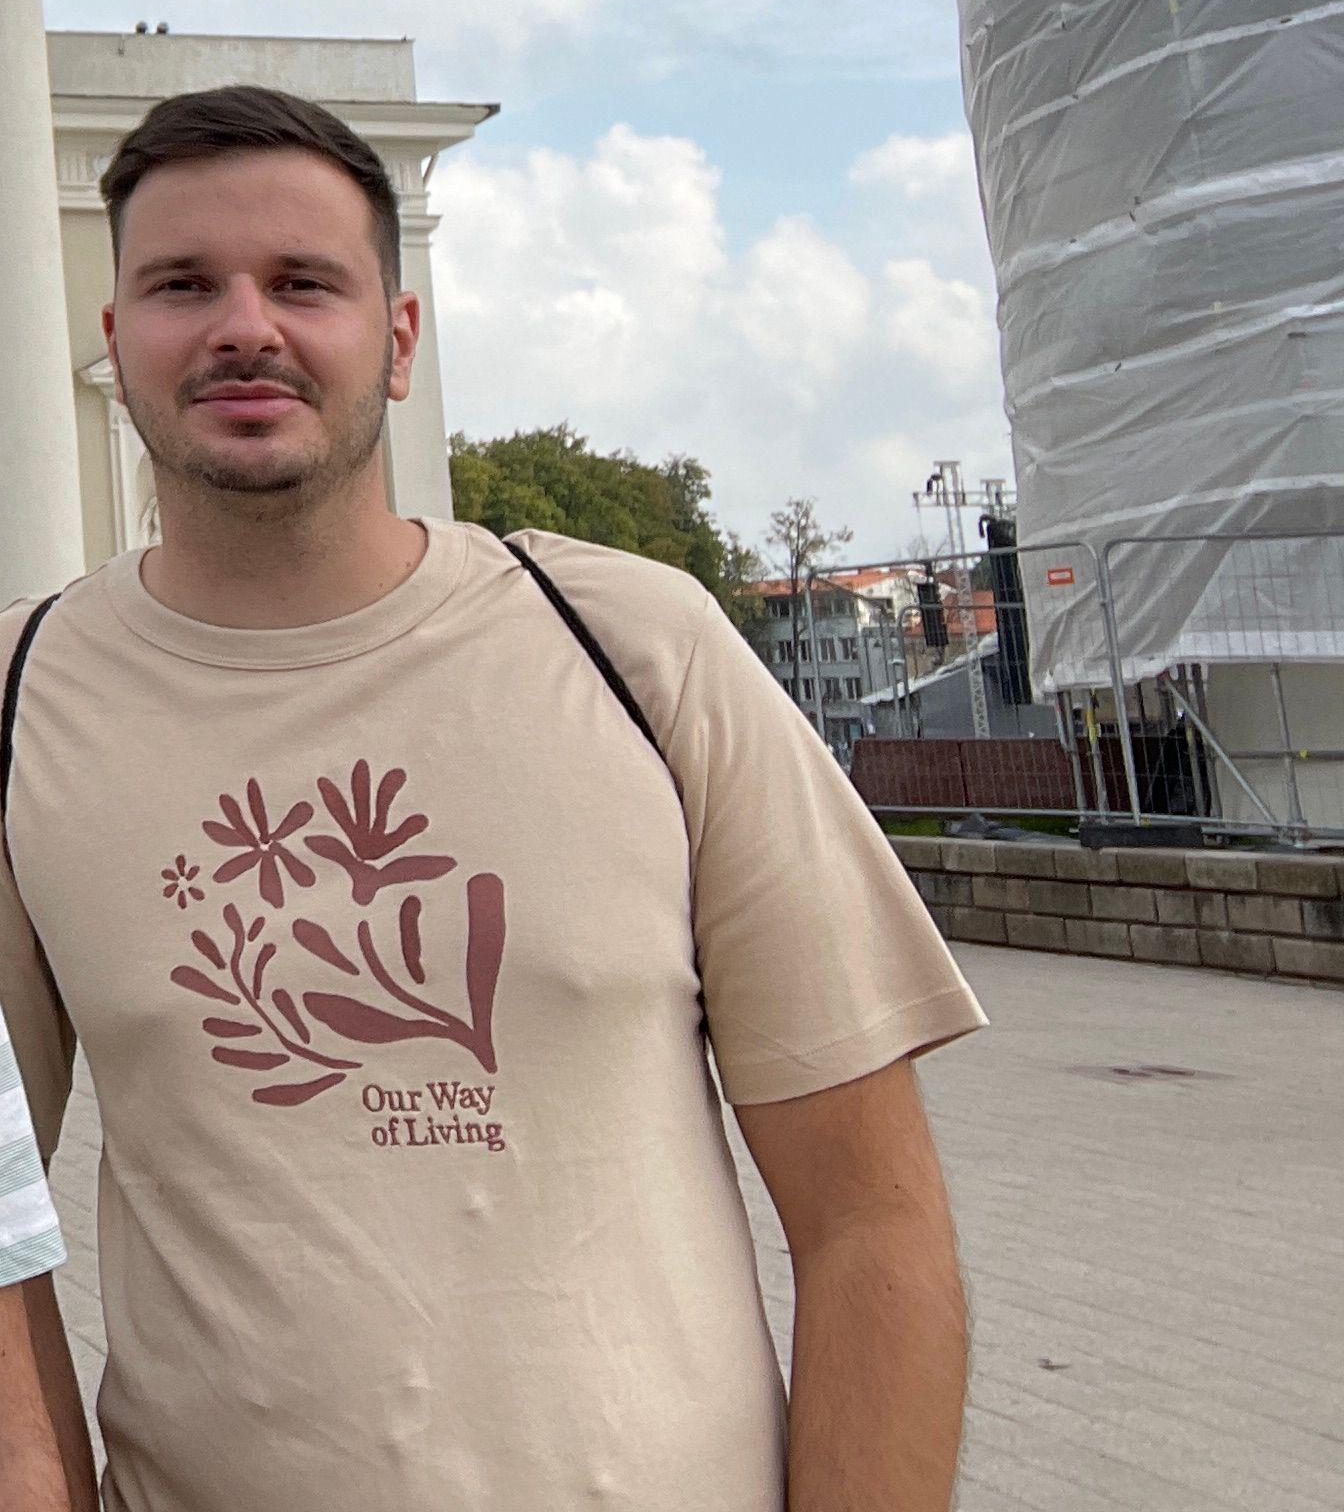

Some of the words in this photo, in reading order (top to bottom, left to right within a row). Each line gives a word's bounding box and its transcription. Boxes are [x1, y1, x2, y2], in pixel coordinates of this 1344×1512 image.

[362, 1083, 422, 1113] Our
[425, 1080, 496, 1116] Way
[370, 1115, 400, 1147] of
[402, 1114, 506, 1152] Living
